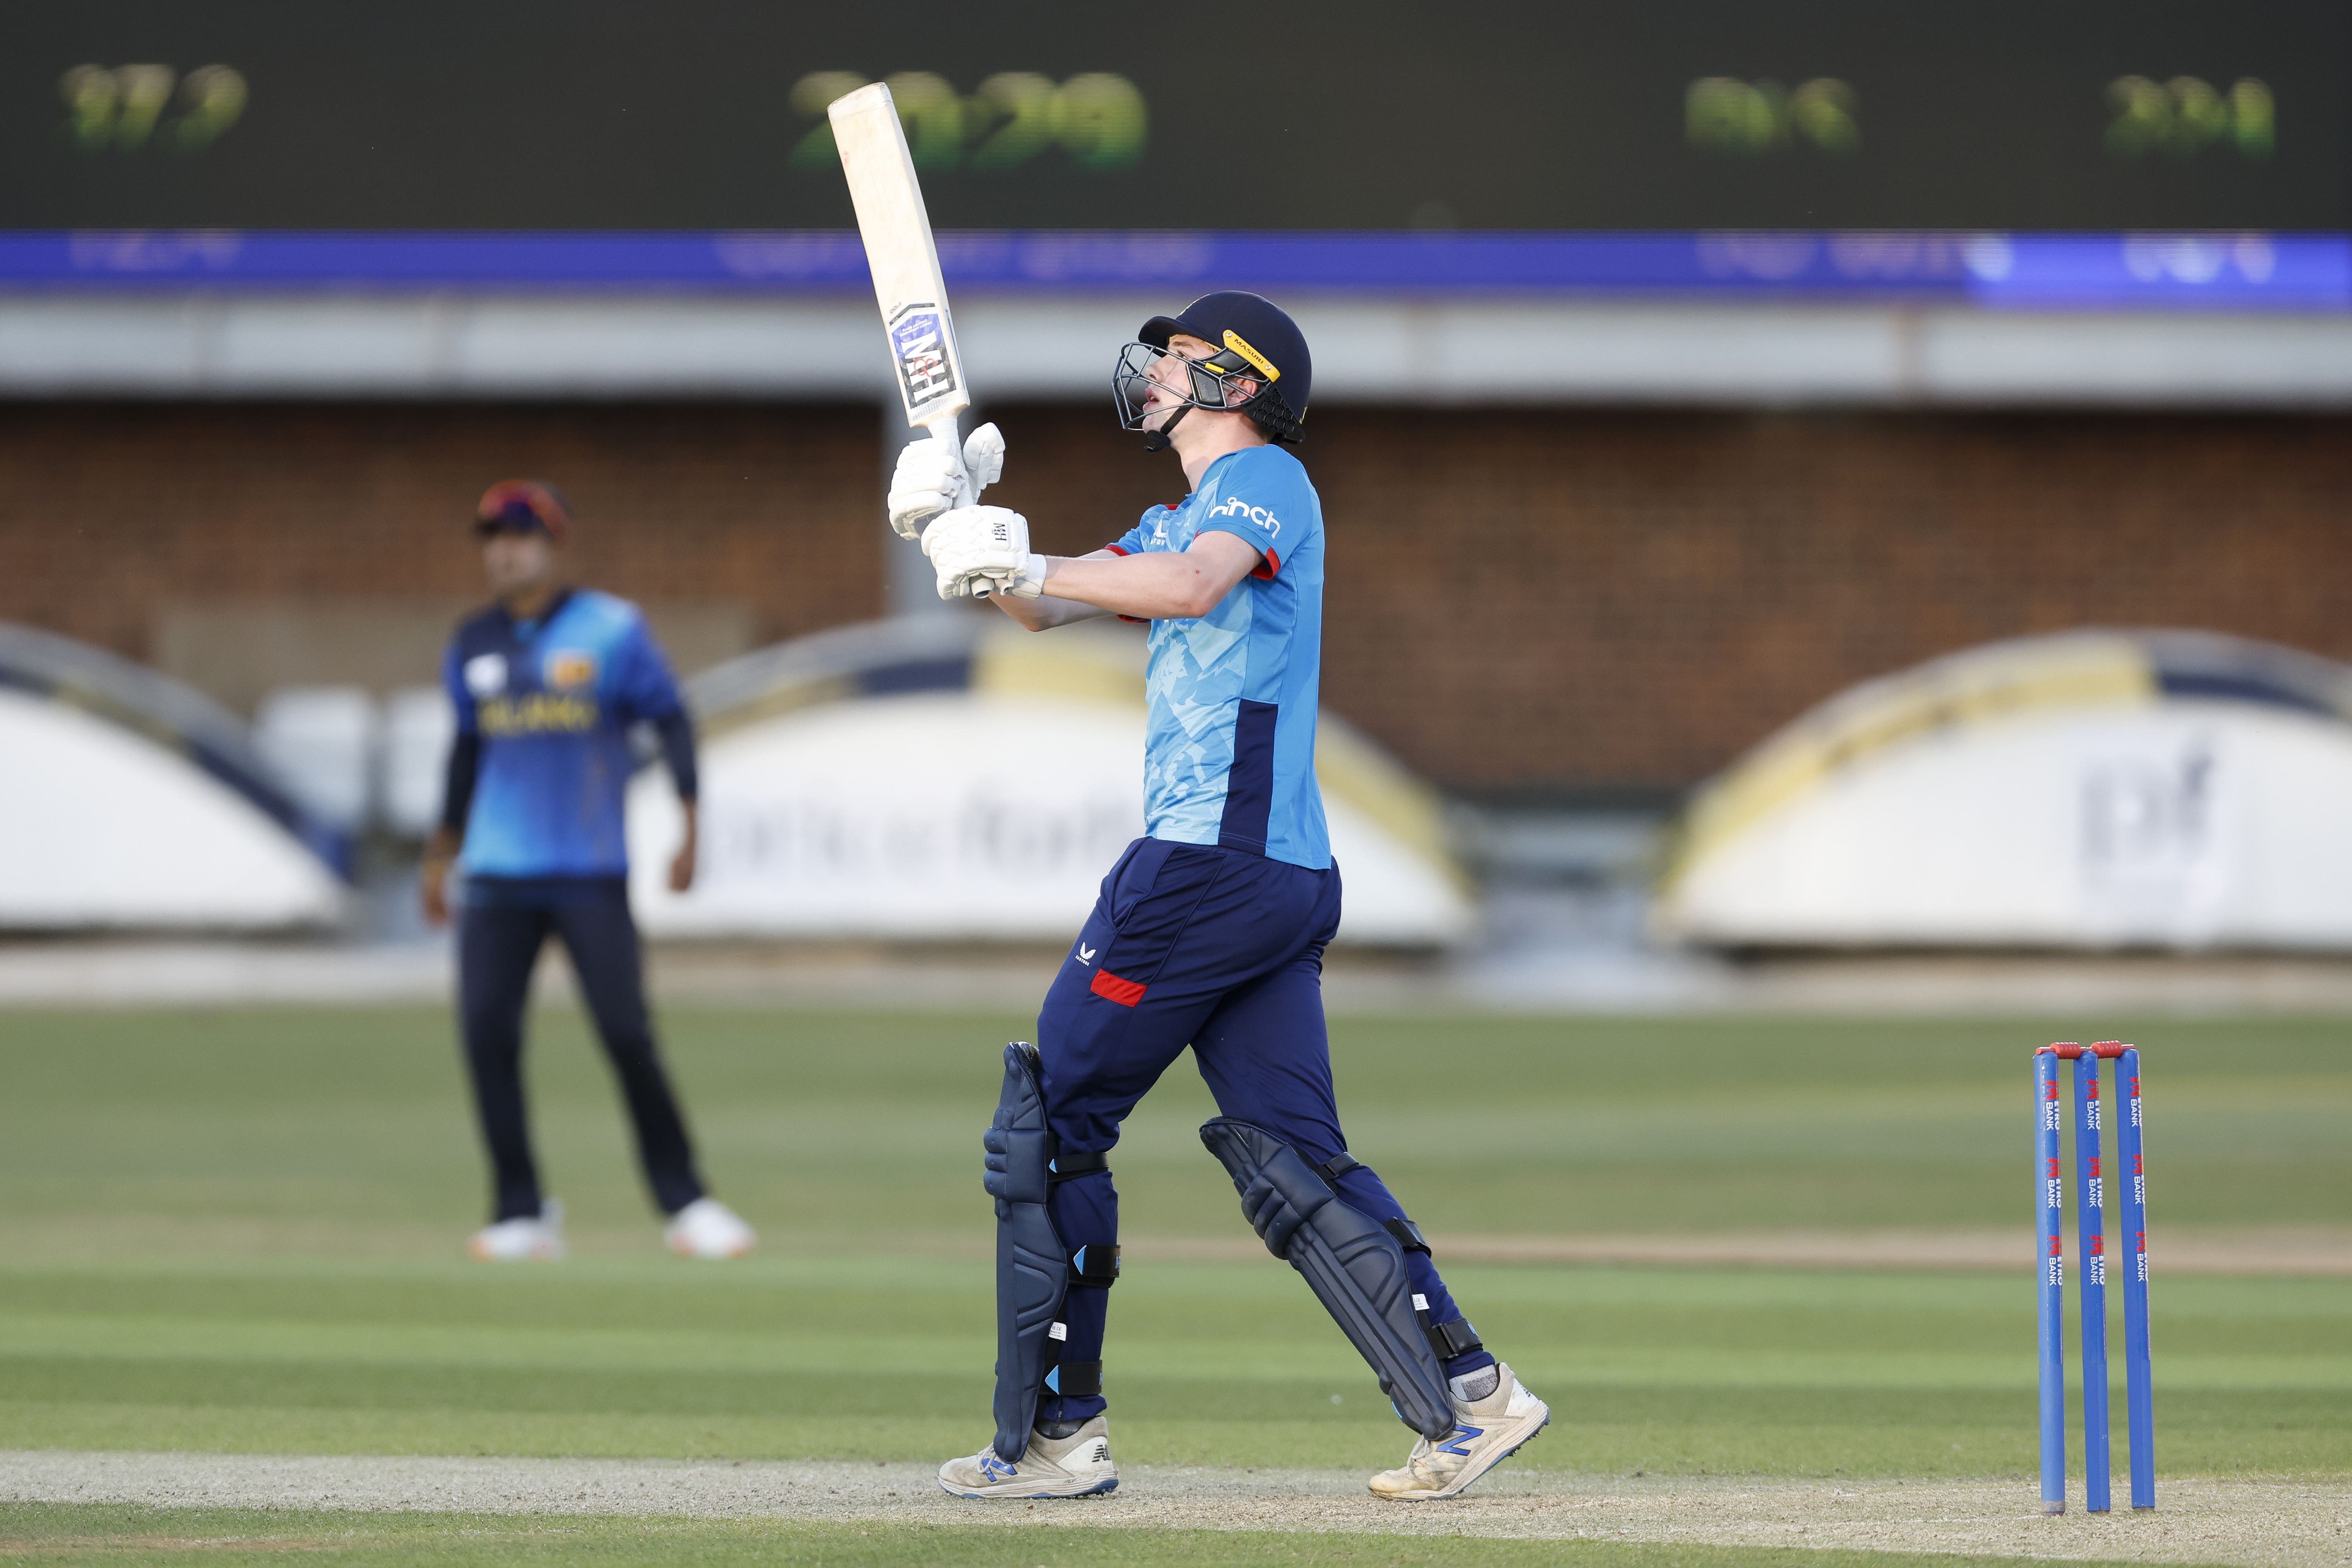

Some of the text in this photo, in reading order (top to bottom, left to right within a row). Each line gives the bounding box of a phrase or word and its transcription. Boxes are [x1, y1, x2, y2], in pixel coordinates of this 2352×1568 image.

[1234, 339, 1263, 364] MASURI
[2046, 1102, 2054, 1131] BANK
[2087, 1101, 2095, 1130] BANK
[2130, 1099, 2139, 1127] BANK
[2089, 1179, 2097, 1208] BANK
[2091, 1257, 2099, 1285] BANK
